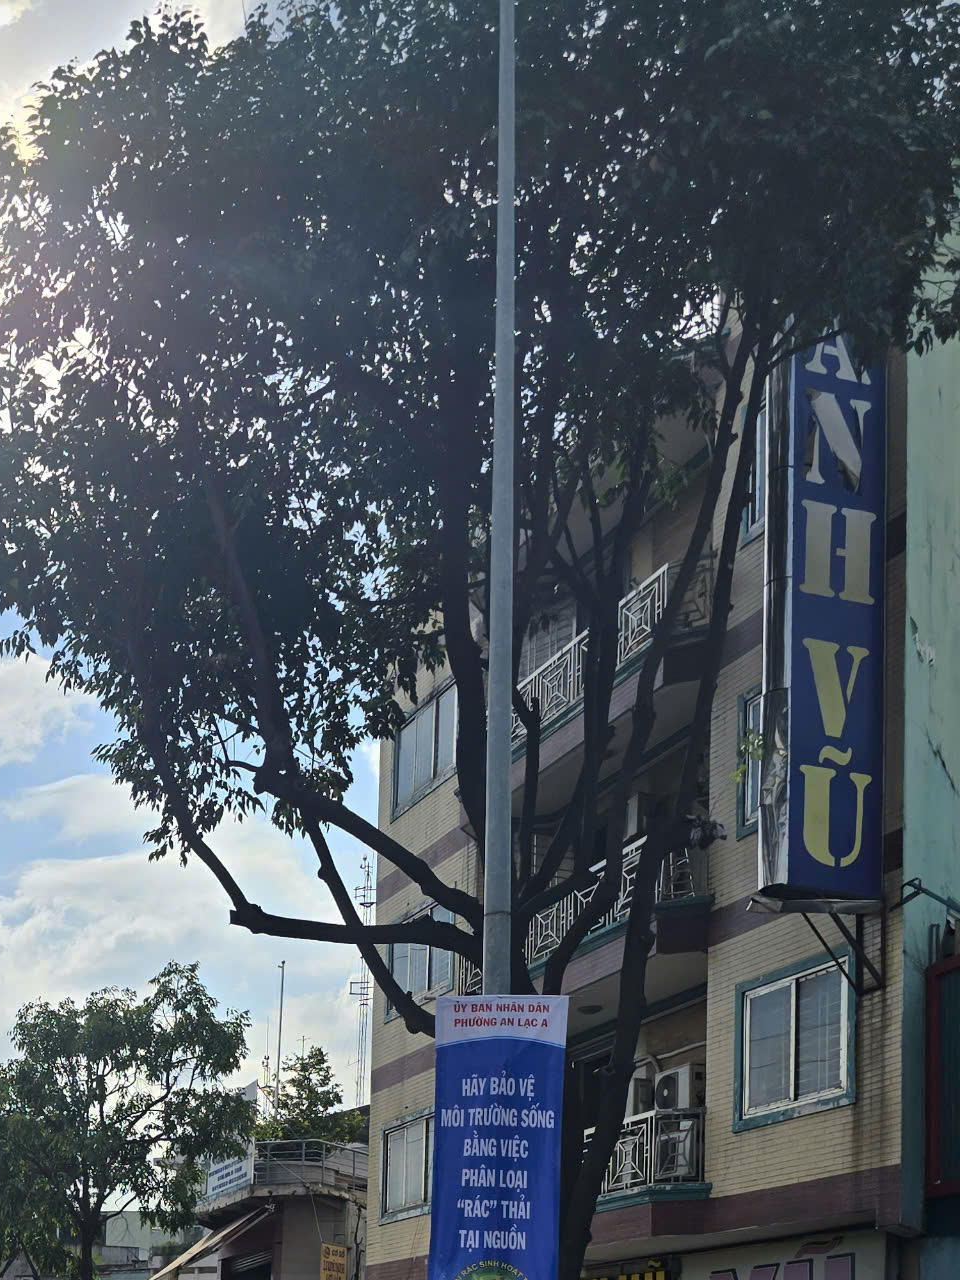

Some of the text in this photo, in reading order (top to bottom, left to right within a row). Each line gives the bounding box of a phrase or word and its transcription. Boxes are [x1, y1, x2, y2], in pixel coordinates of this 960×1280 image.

[799, 312, 876, 867] ANH VŨ
[453, 1001, 550, 1013] ỦY BAN NHÂN DÂN
[454, 1016, 548, 1029] PHƯỜNG AN LẠC A
[462, 1070, 535, 1101] HÃY BẢO VỆ
[441, 1103, 555, 1129] MÔI TRƯỜNG SỐNG
[463, 1130, 529, 1162] BẰNG VIỆC
[461, 1164, 528, 1192] PHÂN LOẠI
[501, 1194, 531, 1219] THẢI
[459, 1224, 526, 1252] TẠI NGUỒN
[479, 1260, 499, 1268] SINH
